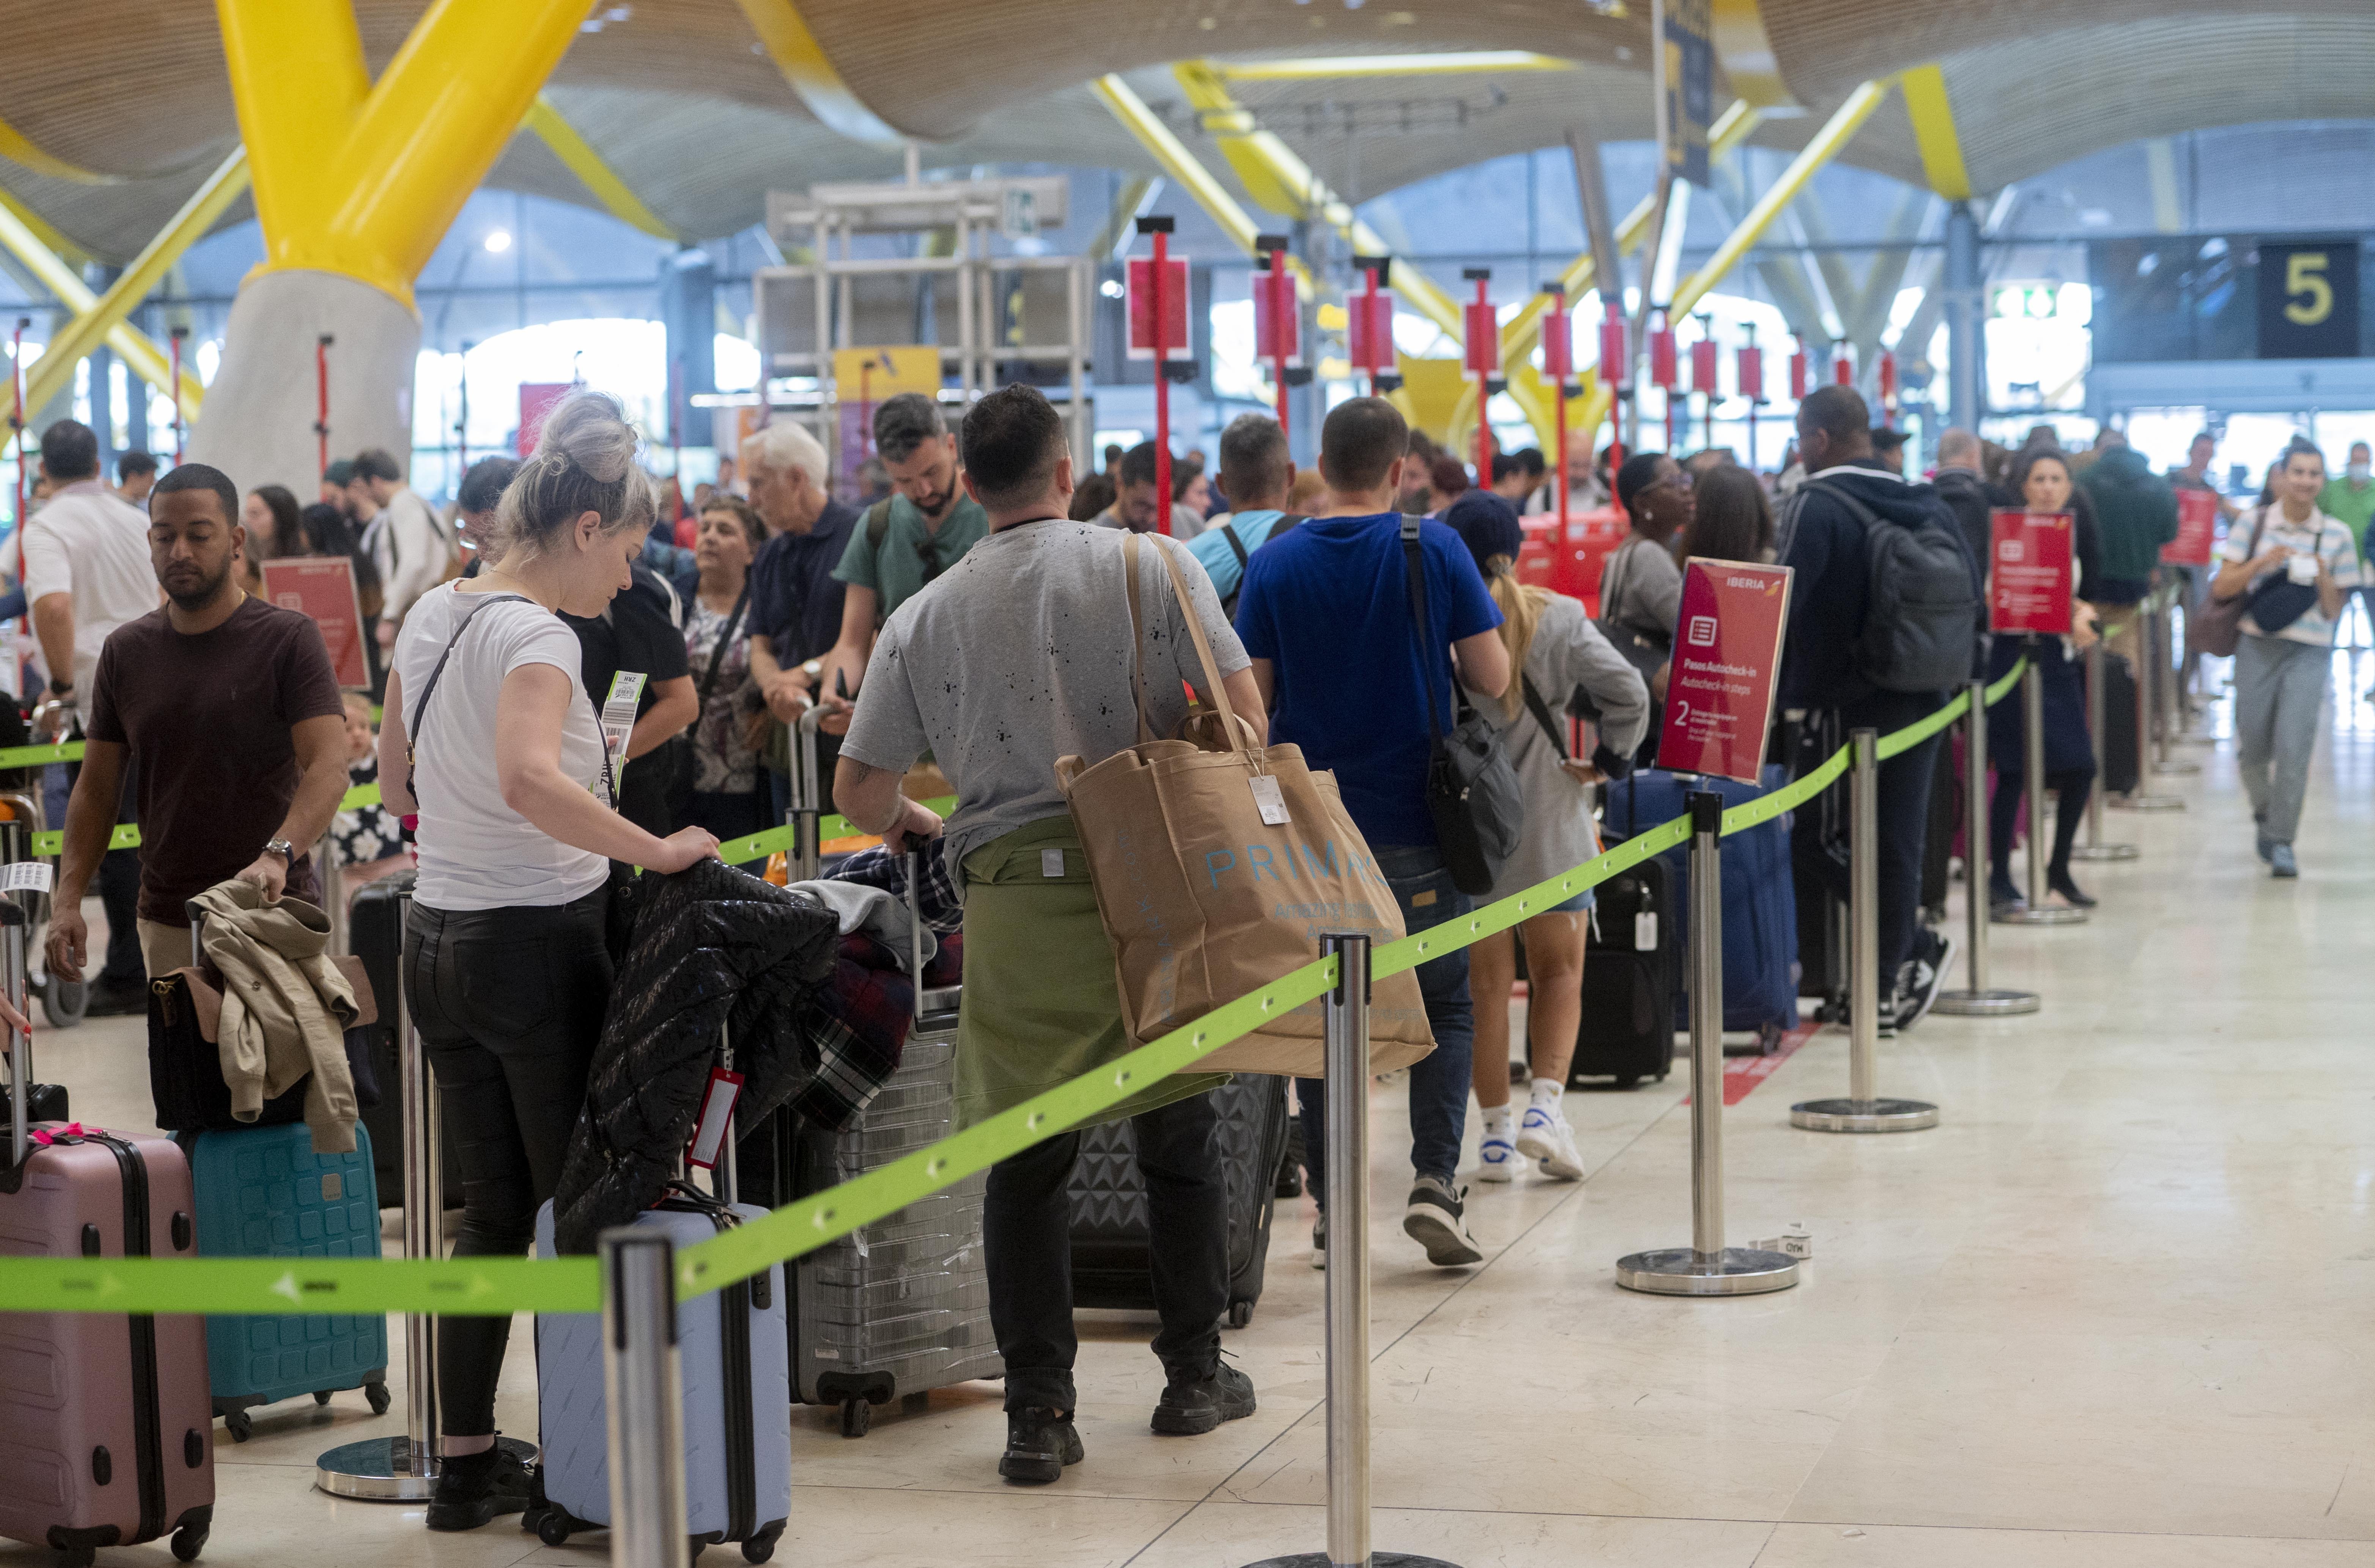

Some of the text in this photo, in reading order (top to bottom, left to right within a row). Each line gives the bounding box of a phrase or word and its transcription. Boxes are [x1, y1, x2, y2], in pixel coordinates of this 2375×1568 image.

[2284, 253, 2333, 325] 5
[1727, 577, 1765, 591] IBERIA
[1684, 657, 1757, 678] Pasos Autocheck-in
[1680, 676, 1751, 696] Autocheck-in steps
[1674, 700, 1689, 727] 2
[1274, 897, 1379, 922] Amazing fashio
